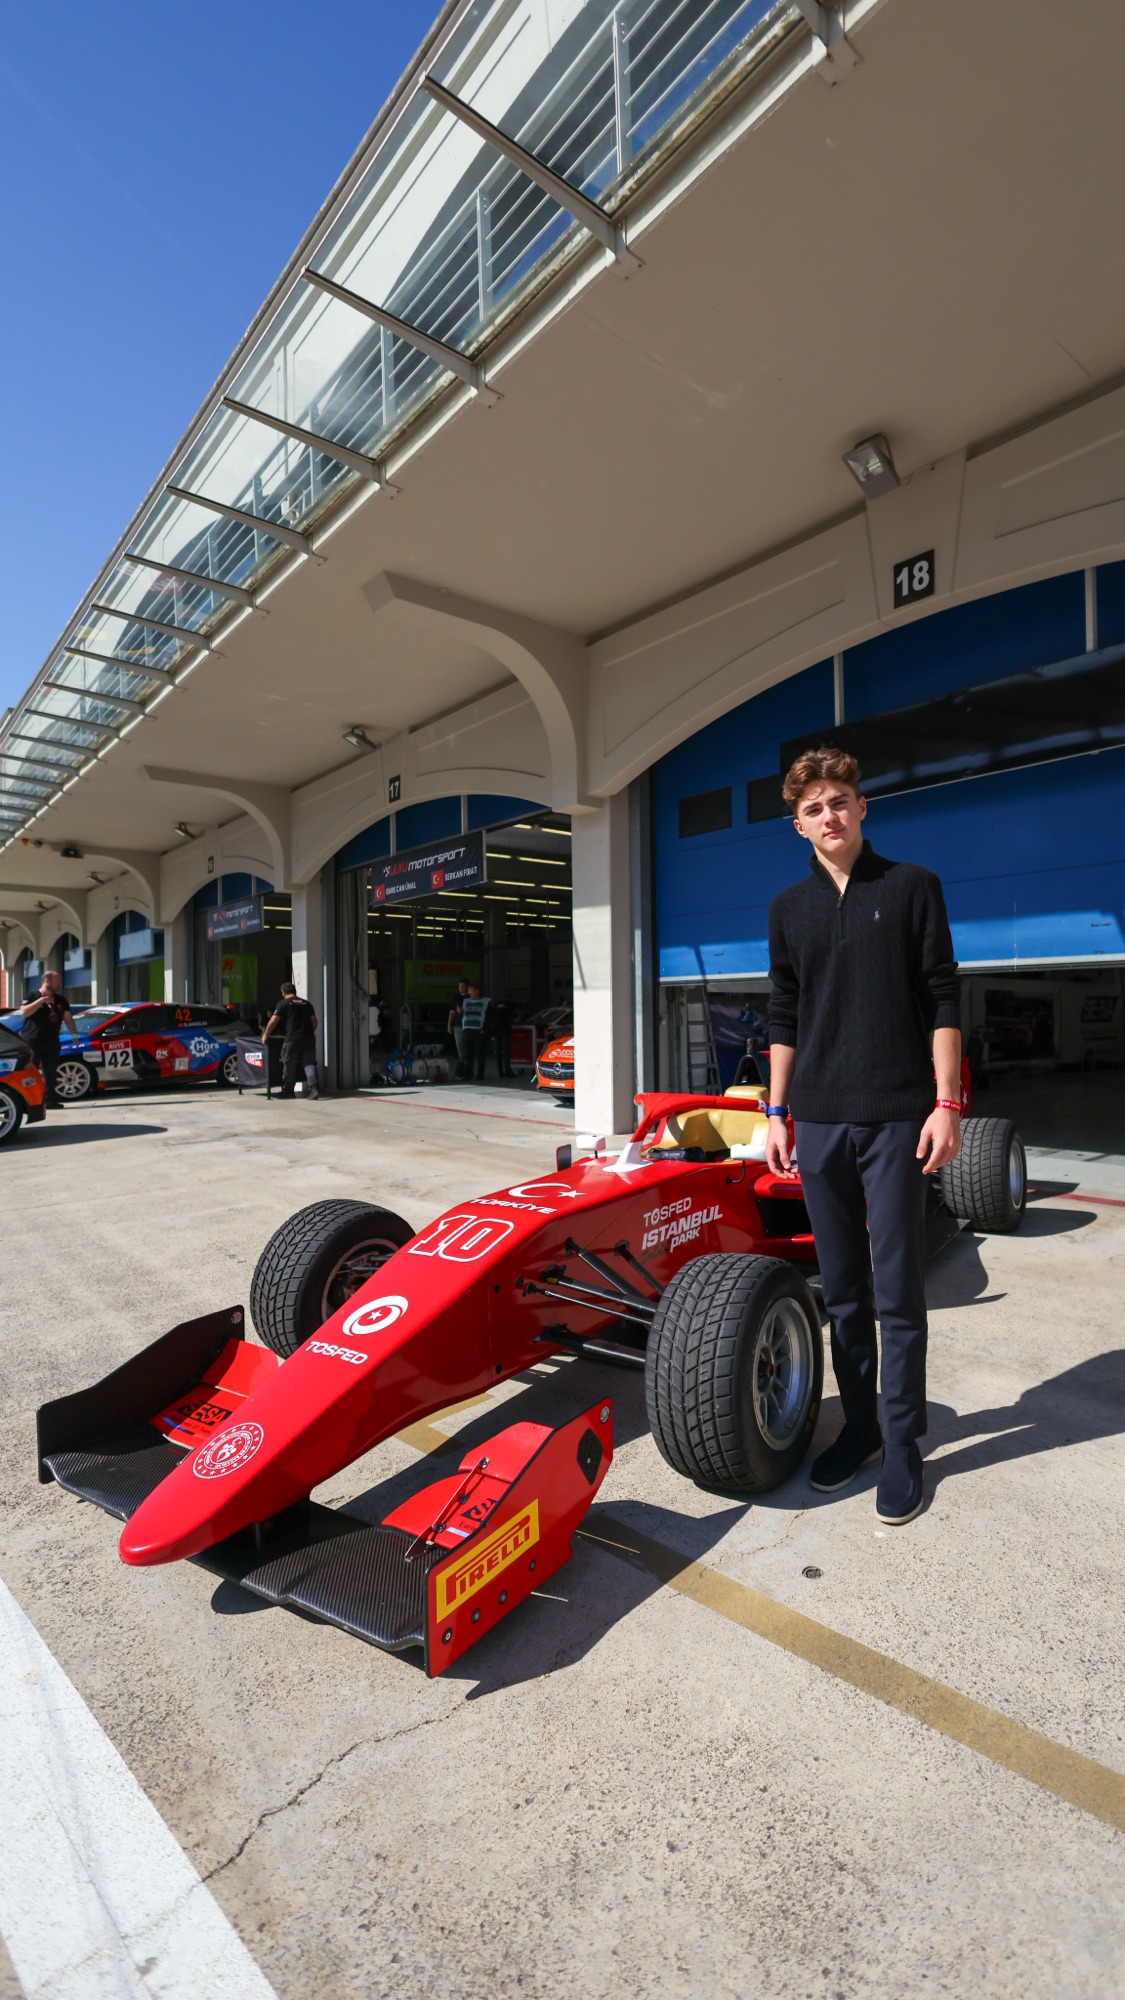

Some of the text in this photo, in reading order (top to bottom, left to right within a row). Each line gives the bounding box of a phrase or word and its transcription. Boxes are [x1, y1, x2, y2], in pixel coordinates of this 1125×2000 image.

[896, 560, 930, 597] 18
[389, 780, 400, 799] 17
[444, 870, 464, 881] SERKAN
[175, 1008, 192, 1022] 42
[108, 1042, 125, 1050] AVIS
[107, 1050, 131, 1068] 42
[940, 1099, 951, 1107] VIP
[643, 1196, 692, 1227] TOSFED
[407, 1214, 515, 1263] 10
[641, 1204, 724, 1251] ISTANBUL
[670, 1226, 702, 1253] PARK
[305, 1340, 369, 1365] TOSFED
[445, 1514, 531, 1607] PIRELLI
